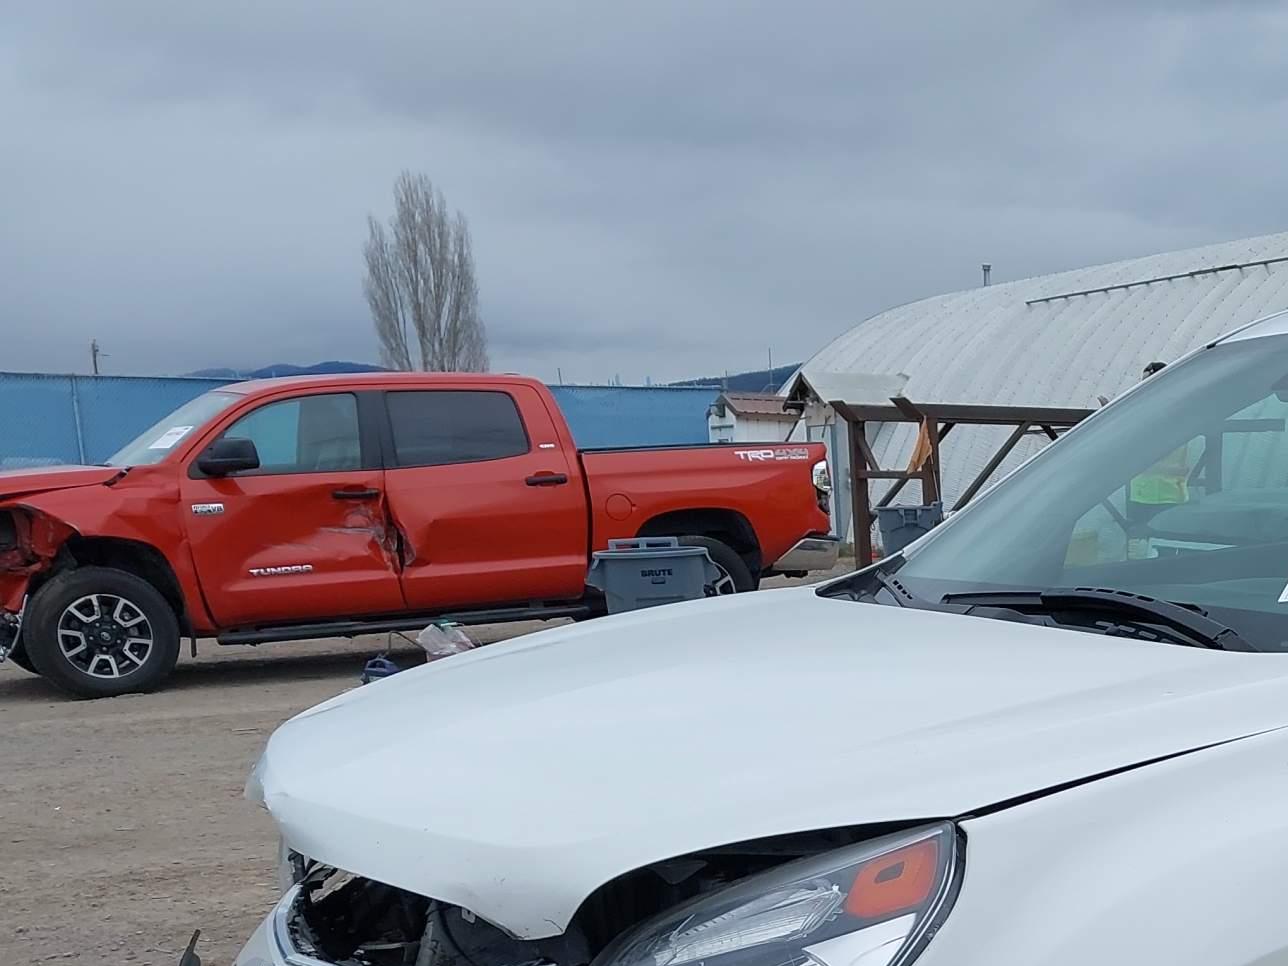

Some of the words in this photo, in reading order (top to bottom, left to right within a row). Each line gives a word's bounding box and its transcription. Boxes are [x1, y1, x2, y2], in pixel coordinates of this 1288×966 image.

[734, 449, 774, 461] TRD
[249, 564, 313, 576] TUNDRA
[640, 568, 673, 577] BRUTE
